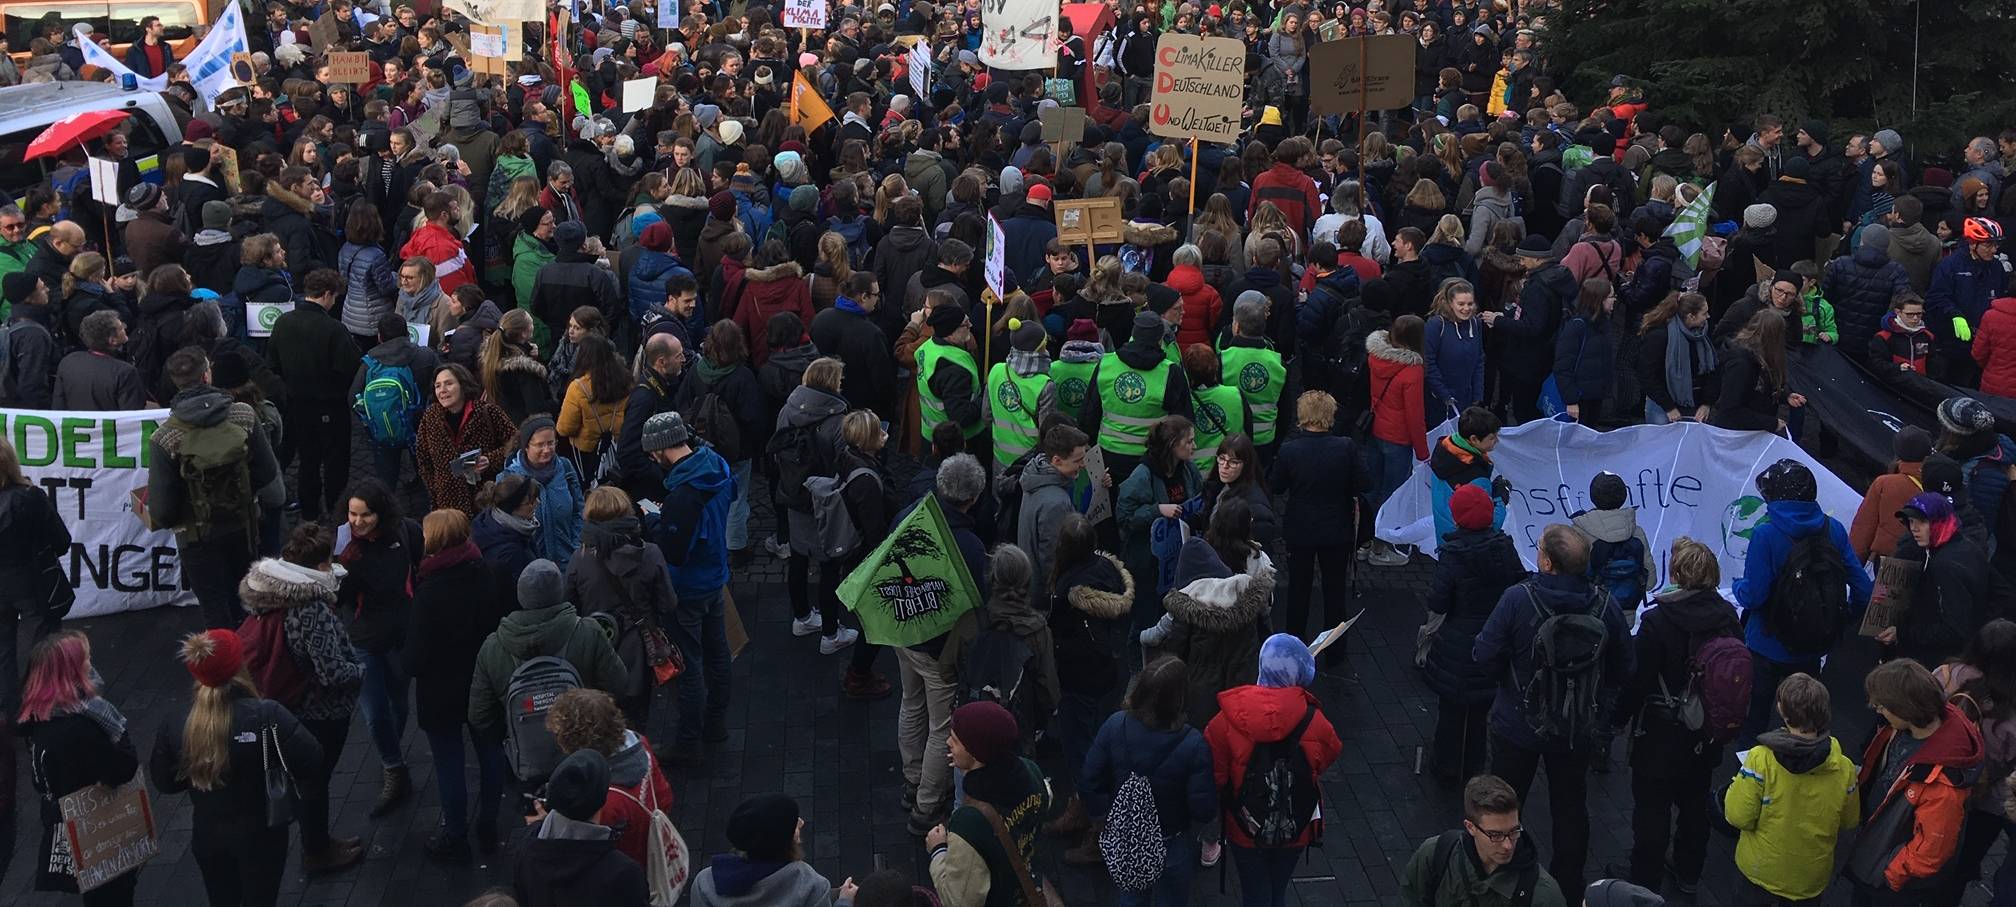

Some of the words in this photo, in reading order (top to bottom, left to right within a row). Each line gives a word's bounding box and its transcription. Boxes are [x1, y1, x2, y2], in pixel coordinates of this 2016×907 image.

[785, 7, 819, 17] KLIMA
[791, 15, 822, 26] POLITIK
[1157, 72, 1241, 99] DEUTSCHLAND
[70, 543, 192, 592] NGE
[48, 863, 63, 873] IM
